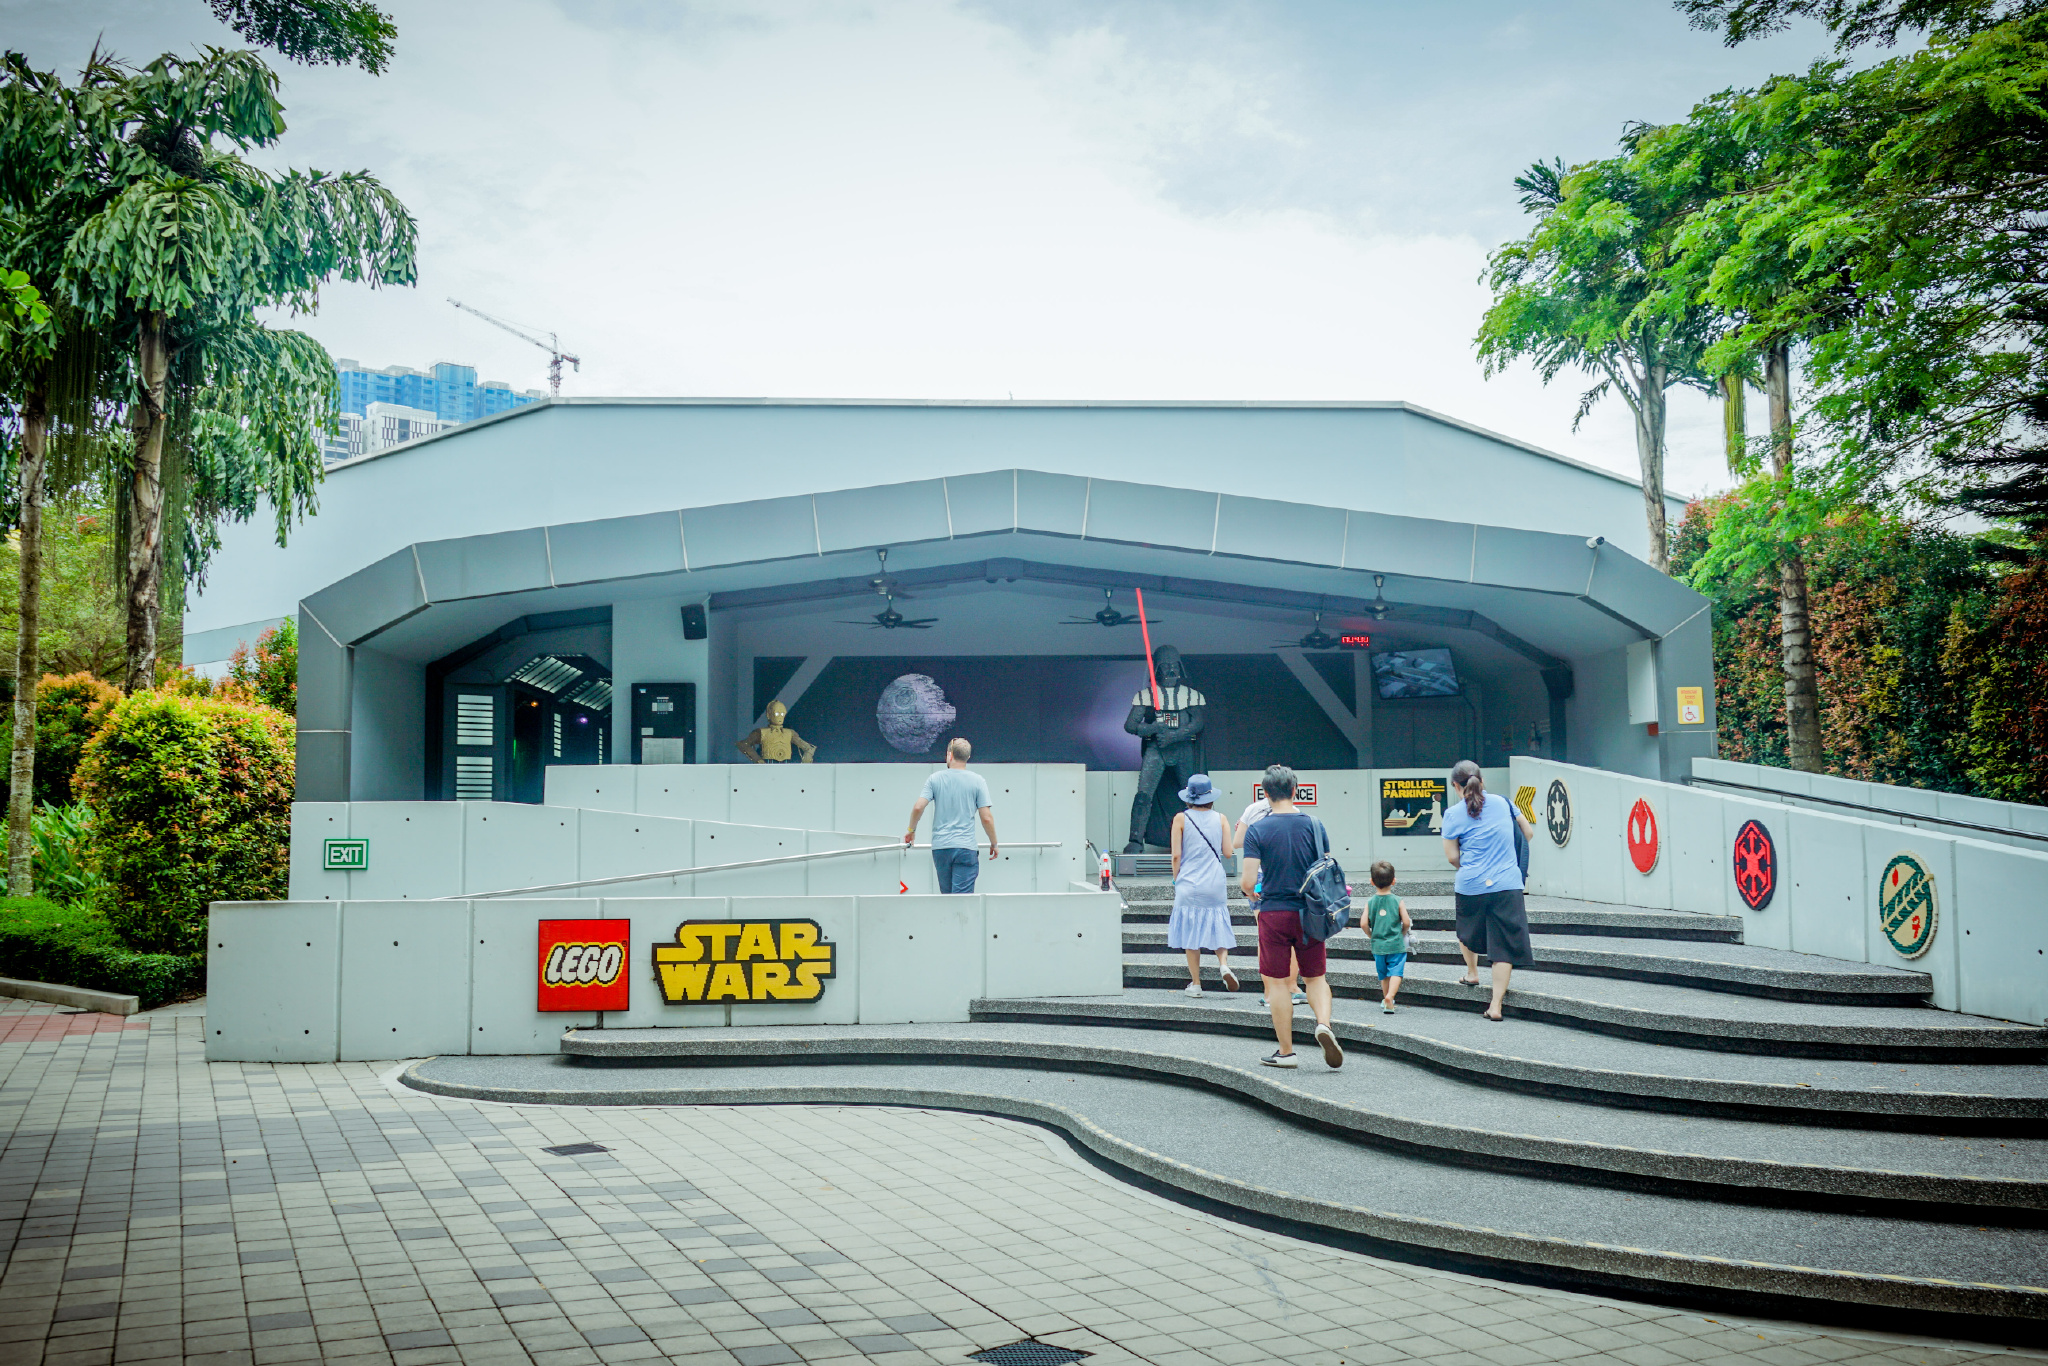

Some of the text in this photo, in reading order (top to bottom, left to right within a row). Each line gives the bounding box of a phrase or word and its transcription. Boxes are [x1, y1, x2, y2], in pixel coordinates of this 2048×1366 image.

[1383, 780, 1445, 790] STROLLER
[1383, 789, 1445, 798] PARKING
[1257, 788, 1313, 801] ENCE
[330, 846, 362, 863] EXIT
[656, 923, 831, 961] STAR
[545, 944, 623, 984] LEGO
[658, 961, 831, 1000] WARS
